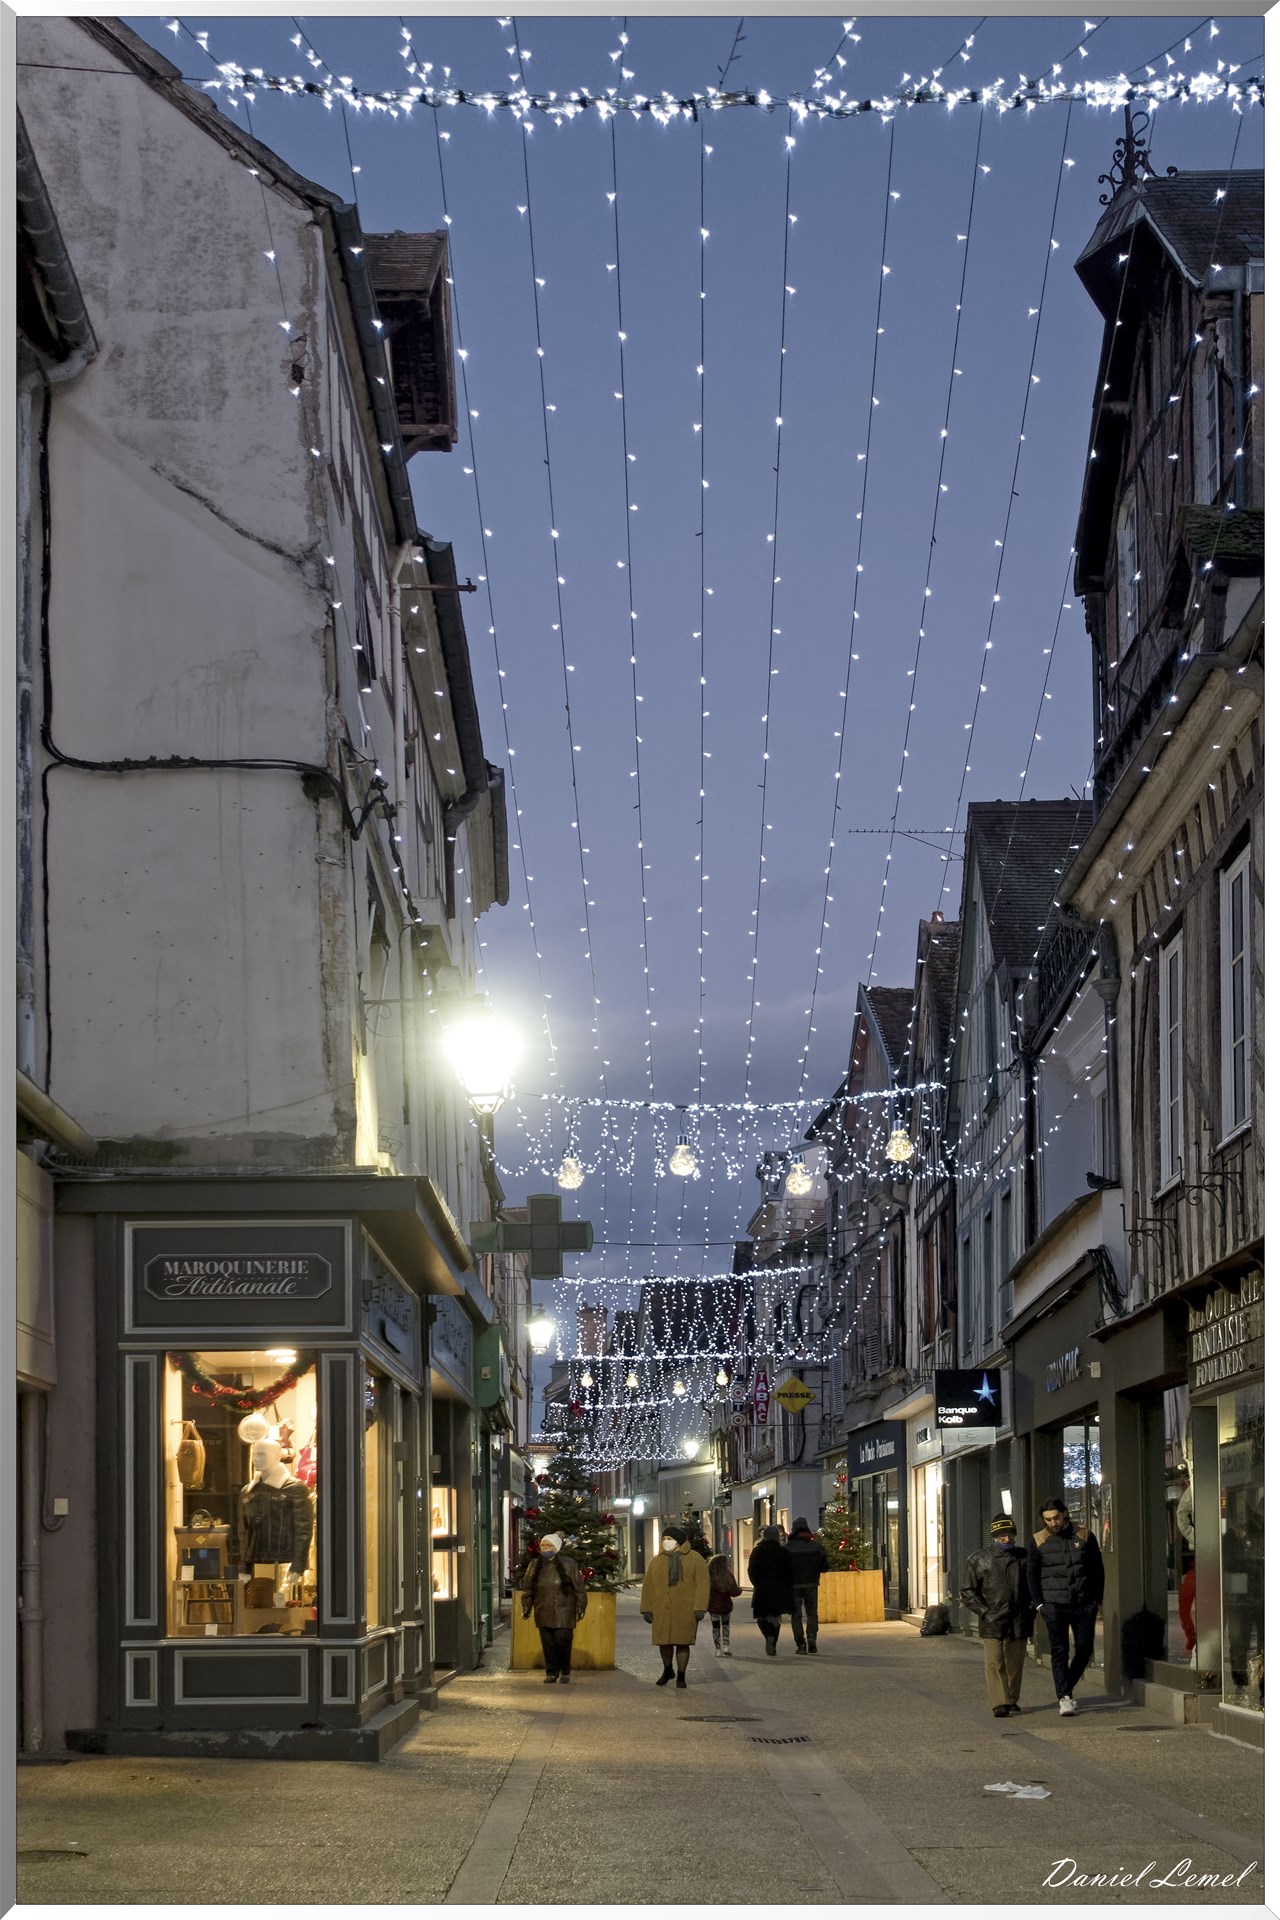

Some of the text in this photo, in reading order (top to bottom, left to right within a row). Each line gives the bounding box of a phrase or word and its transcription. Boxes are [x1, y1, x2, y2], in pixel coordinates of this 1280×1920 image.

[163, 1260, 309, 1278] MAROQUINERIE
[164, 1275, 297, 1295] Artisanale
[1192, 1312, 1246, 1363] FANTAISIE
[1196, 1348, 1245, 1387] FOULARDS
[755, 1372, 768, 1422] TABAC
[938, 1406, 978, 1416] Banque
[938, 1415, 964, 1424] Kolb
